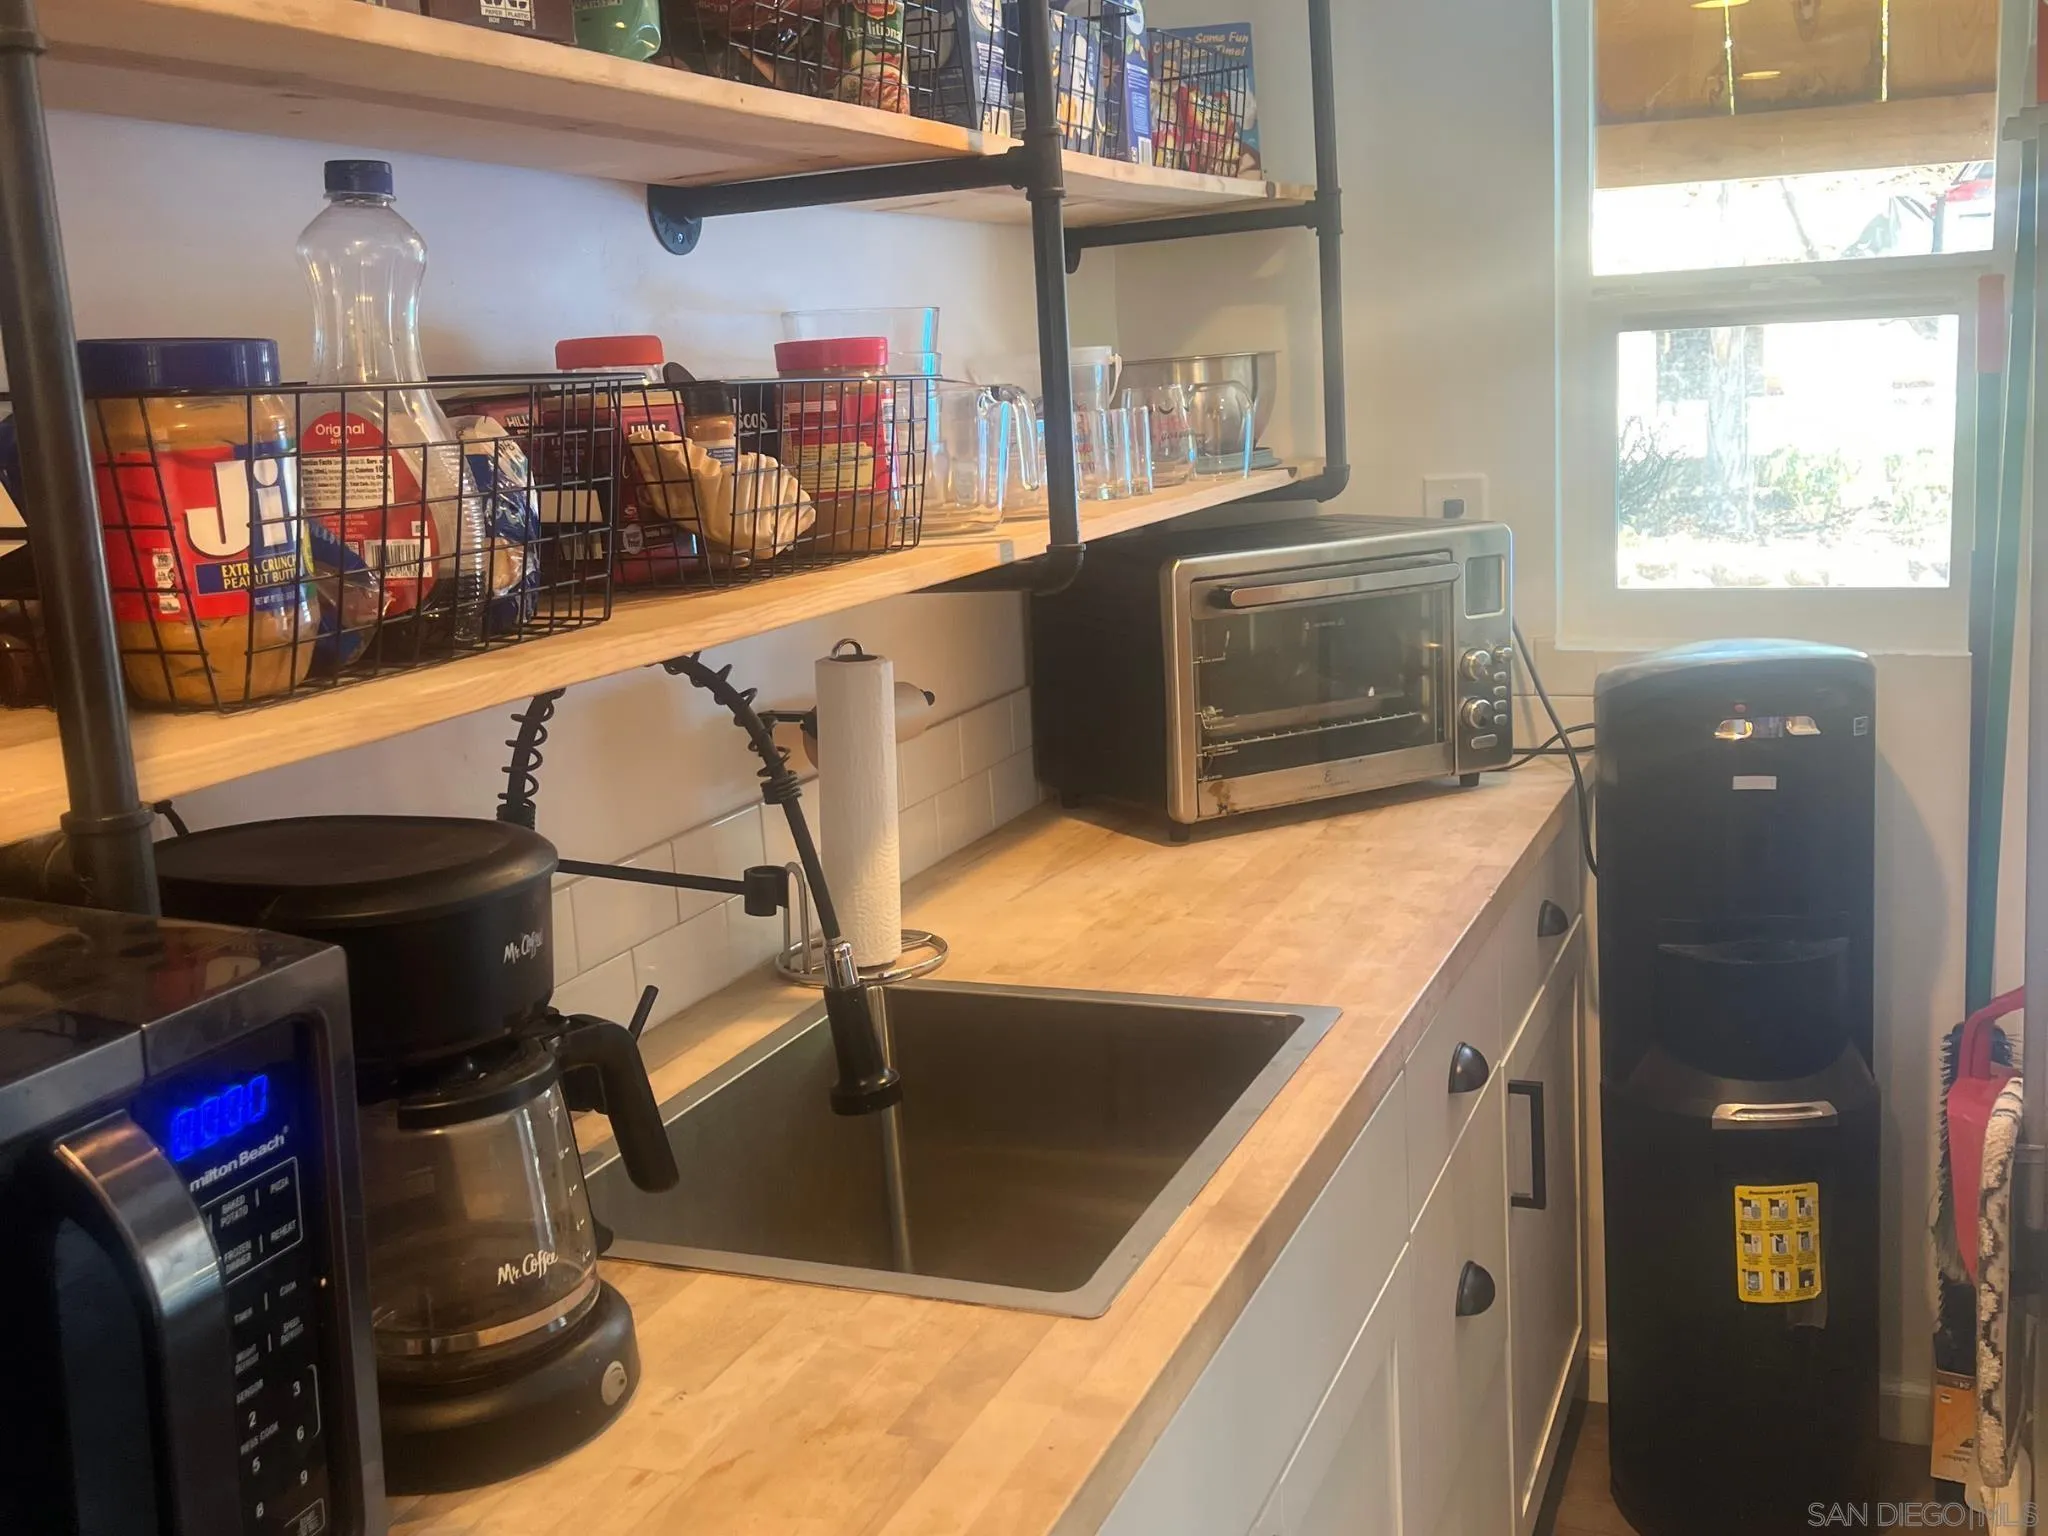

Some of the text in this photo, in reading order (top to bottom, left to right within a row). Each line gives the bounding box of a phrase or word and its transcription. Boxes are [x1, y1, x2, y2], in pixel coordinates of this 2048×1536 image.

[507, 11, 530, 20] PLASTIC
[1229, 31, 1249, 44] Fun
[315, 422, 366, 438] Orignal
[223, 573, 269, 590] PEAUT
[189, 1133, 286, 1194] milton Beach
[497, 1249, 559, 1286] Mr. Coffee
[292, 1380, 301, 1398] 3
[248, 1410, 257, 1429] 2
[296, 1424, 305, 1442] 6
[252, 1456, 261, 1474] 5
[300, 1469, 308, 1486] 9
[255, 1501, 264, 1520] 8
